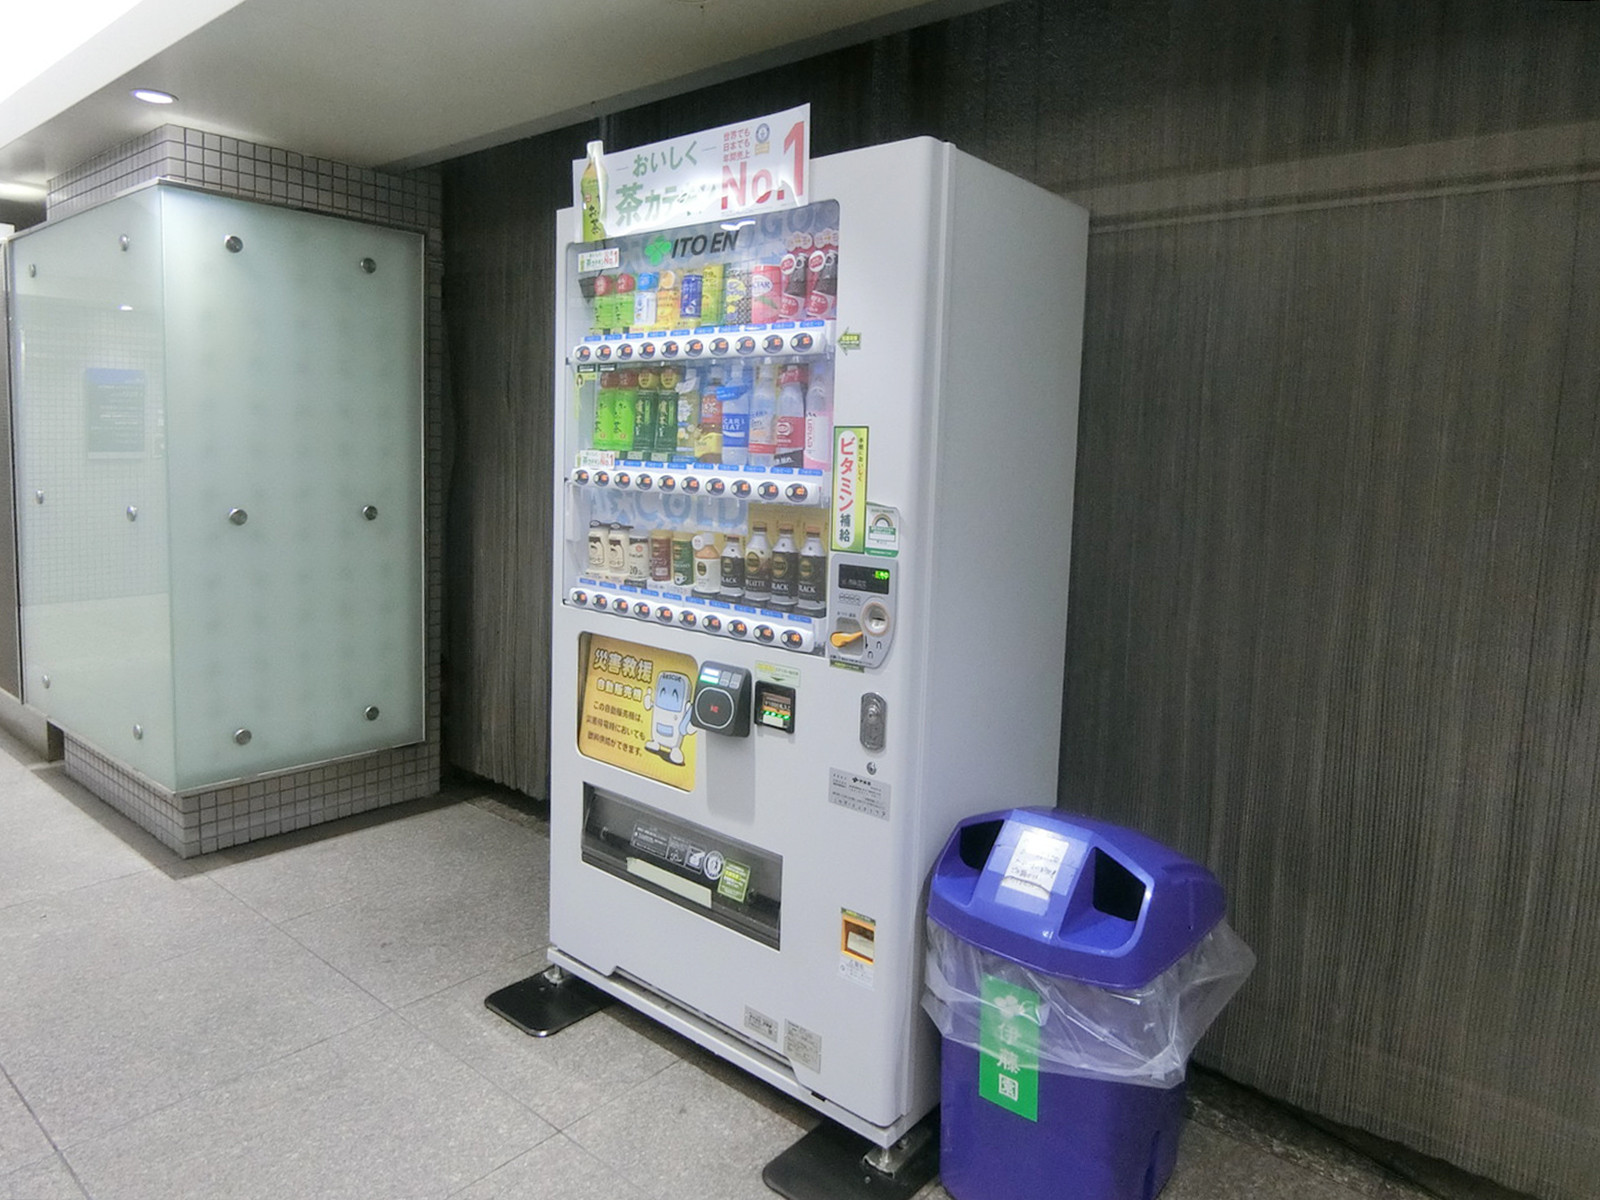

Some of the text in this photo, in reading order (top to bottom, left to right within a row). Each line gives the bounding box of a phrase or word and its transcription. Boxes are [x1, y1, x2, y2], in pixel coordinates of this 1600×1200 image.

[632, 140, 699, 178] おいしく
[721, 121, 806, 210] No.1
[671, 230, 740, 259] ITO EN
[806, 418, 814, 448] evian
[838, 435, 856, 543] ビタミン補給
[593, 647, 654, 684] 災害救援
[596, 676, 643, 703] 自動販売機
[592, 701, 644, 724] この自動販売機は、
